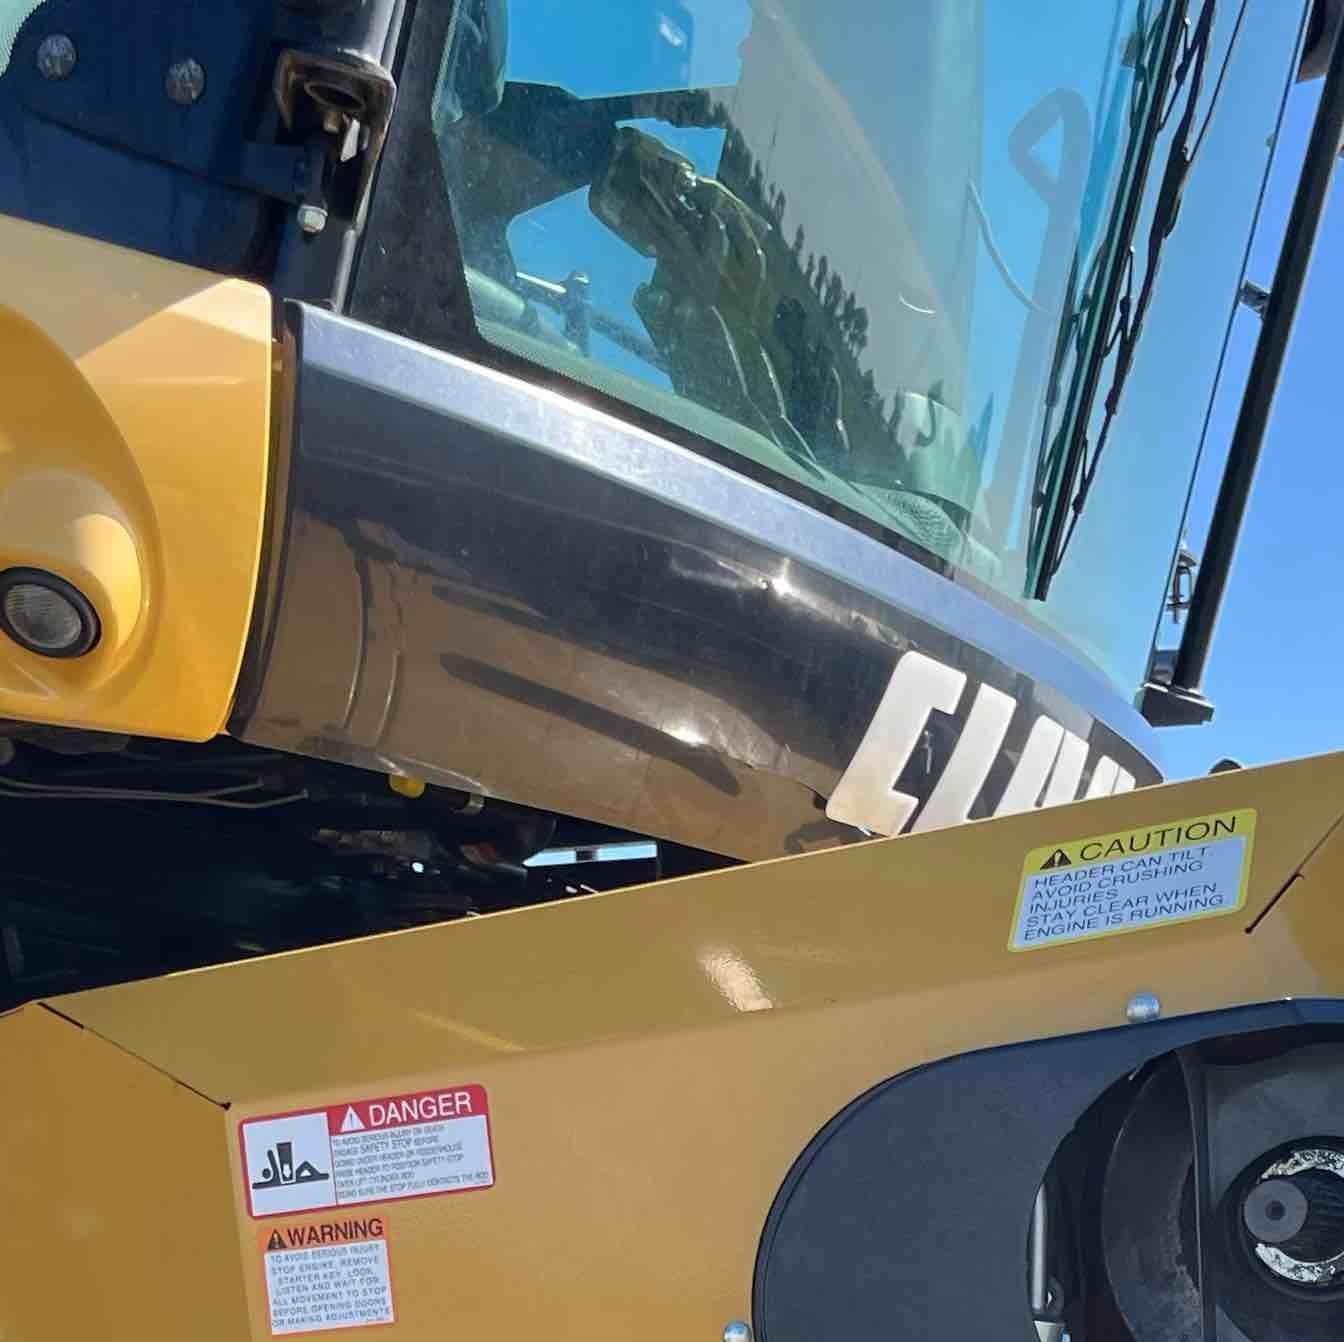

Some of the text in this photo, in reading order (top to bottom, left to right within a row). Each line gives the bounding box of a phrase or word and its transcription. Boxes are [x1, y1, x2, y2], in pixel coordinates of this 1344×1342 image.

[1079, 816, 1236, 862] CAUTION
[1032, 860, 1204, 902] AVOID CRUSHING
[1034, 864, 1115, 889] HEADER
[1120, 856, 1163, 873] CAN
[1027, 882, 1218, 929] STAY CLEAR WHEN
[1029, 888, 1119, 914] INJURIES
[1023, 894, 1225, 942] ENGINE IS RUNNING
[368, 1091, 473, 1127] DANGER
[360, 1142, 389, 1154] SAFETY
[392, 1139, 412, 1150] STOP
[287, 1217, 384, 1247] WARNING
[272, 1264, 296, 1275] STOP
[312, 1281, 331, 1291] AND
[334, 1278, 358, 1289] WAIT
[360, 1276, 379, 1286] FOR
[272, 1286, 387, 1306] ALL MOVEMENT TO STOP
